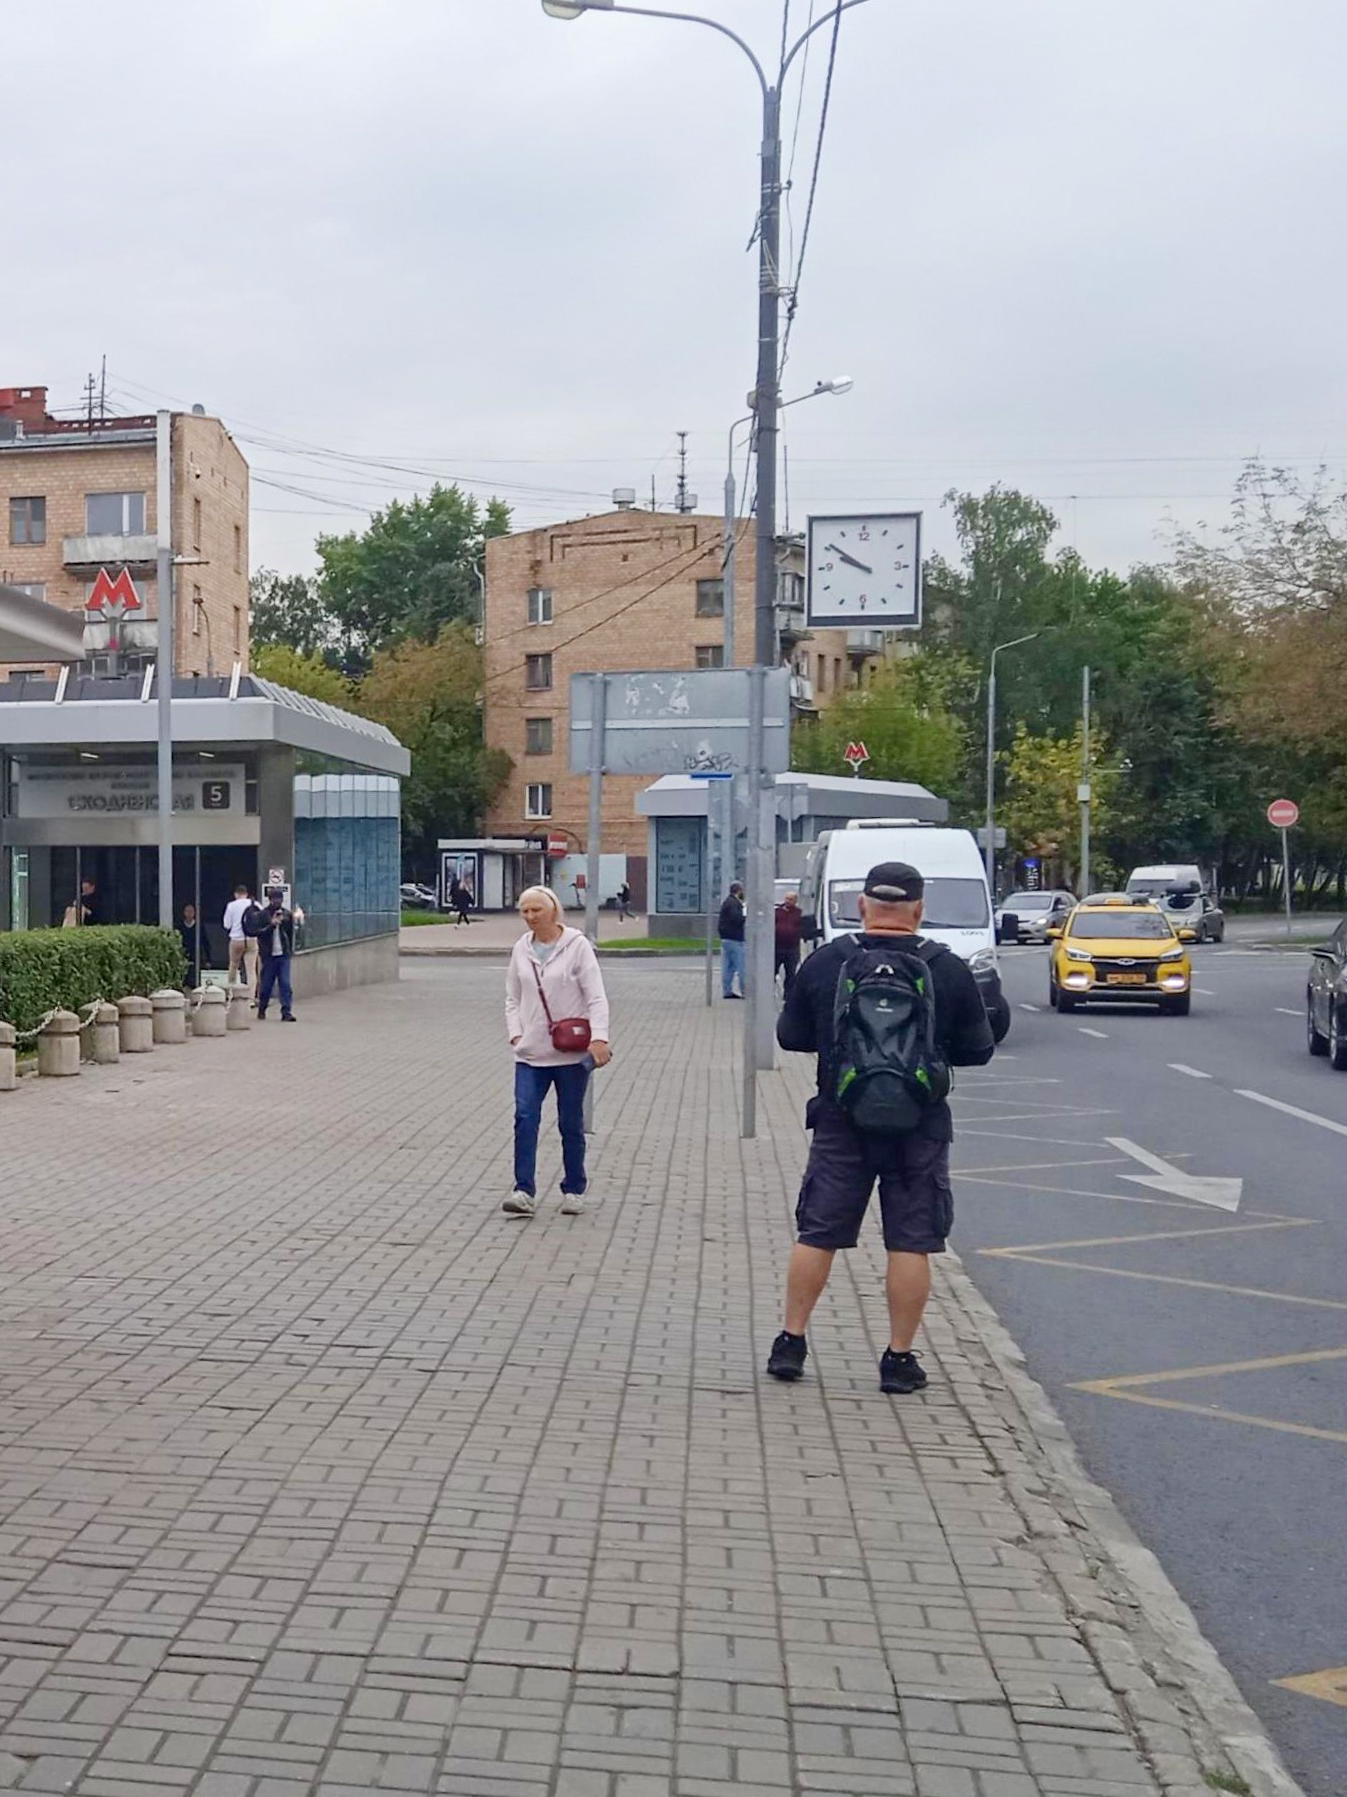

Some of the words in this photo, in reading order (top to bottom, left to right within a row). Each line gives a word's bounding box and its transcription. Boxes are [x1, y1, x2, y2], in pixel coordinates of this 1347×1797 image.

[858, 531, 870, 542] 12
[825, 562, 834, 572] 9
[893, 561, 902, 571] 3
[858, 594, 867, 605] 6
[68, 793, 195, 812] СХОДНЕНСАЯ
[210, 785, 223, 801] 5
